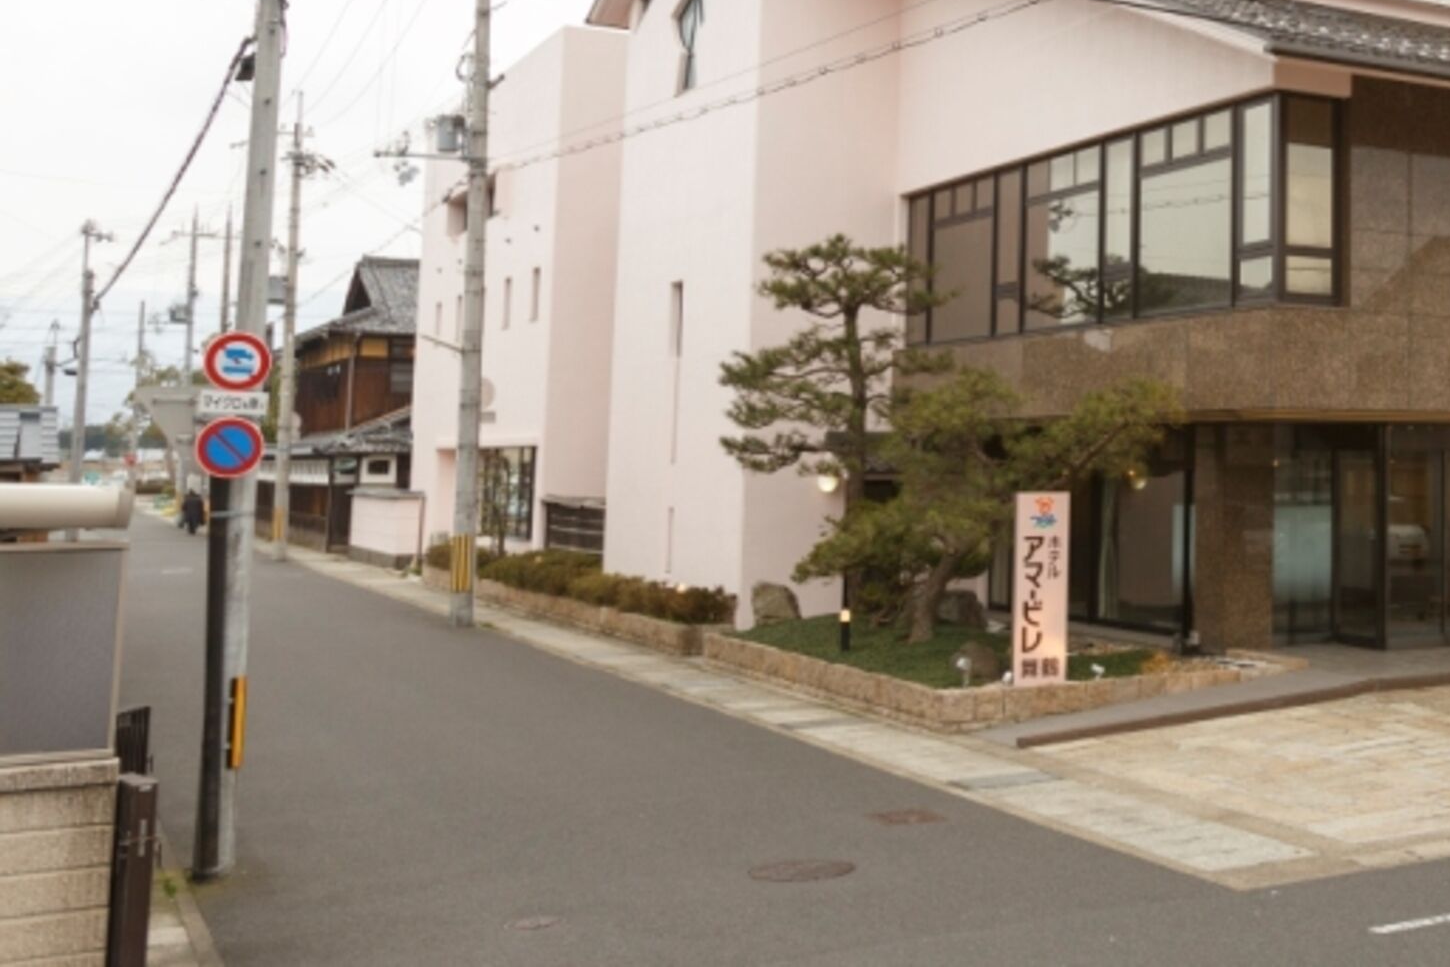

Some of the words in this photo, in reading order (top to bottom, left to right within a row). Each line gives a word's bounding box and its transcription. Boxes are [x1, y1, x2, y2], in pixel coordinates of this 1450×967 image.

[1021, 535, 1045, 654] アマービレ
[1048, 535, 1061, 580] ホテル
